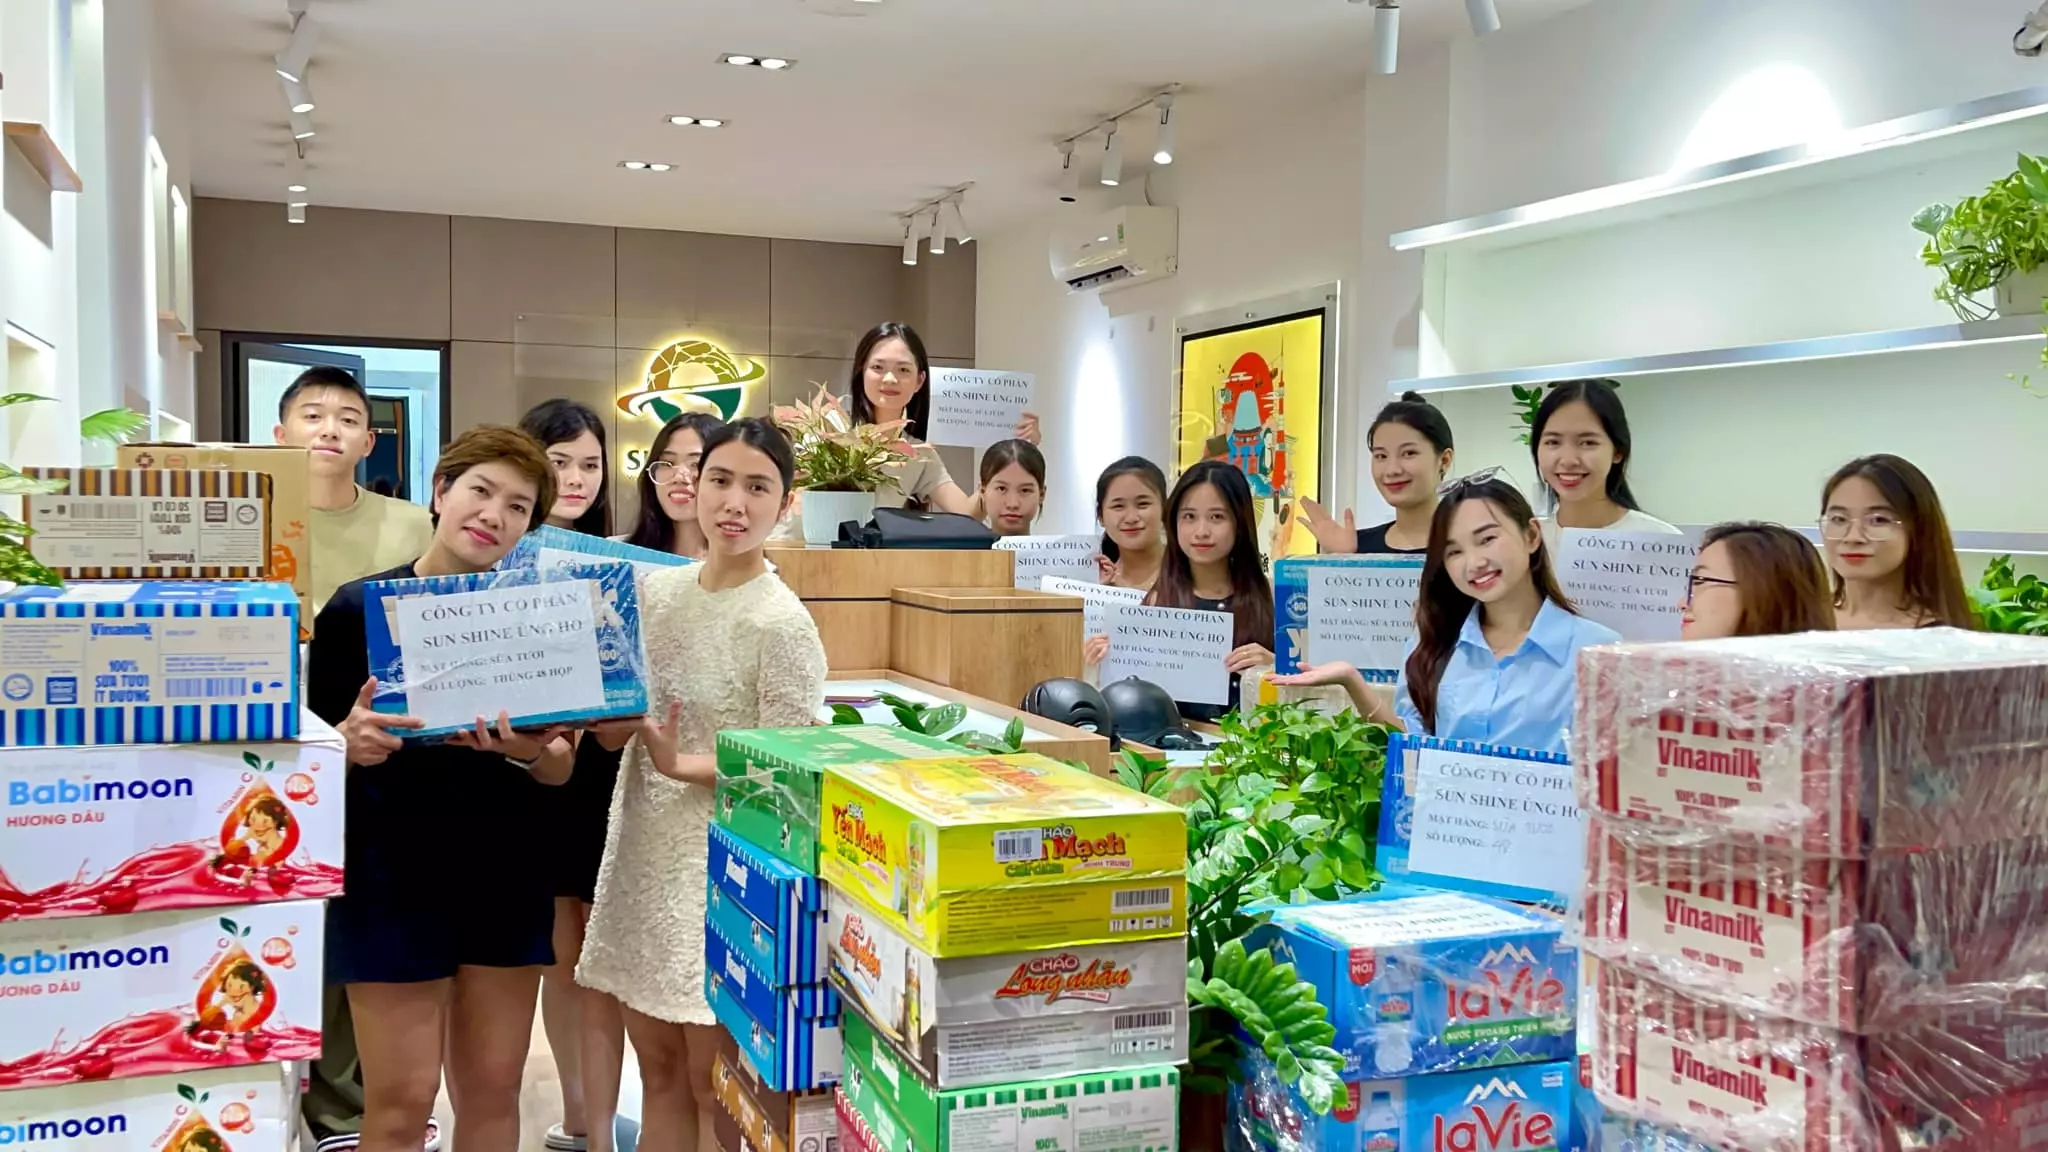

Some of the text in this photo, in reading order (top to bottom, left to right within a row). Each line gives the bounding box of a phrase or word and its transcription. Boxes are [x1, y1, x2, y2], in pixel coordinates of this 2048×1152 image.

[422, 633, 456, 648] SUN
[460, 626, 513, 644] SHINE
[1658, 737, 1762, 780] Vinamilk
[1492, 770, 1510, 783] TY
[8, 775, 193, 806] Babimoon
[1434, 789, 1466, 804] SUN
[1470, 794, 1520, 811] SHINE
[1665, 895, 1765, 947] Vinamilk
[1672, 1046, 1768, 1107] Vinamilk
[1020, 1103, 1068, 1121] Vinamilk
